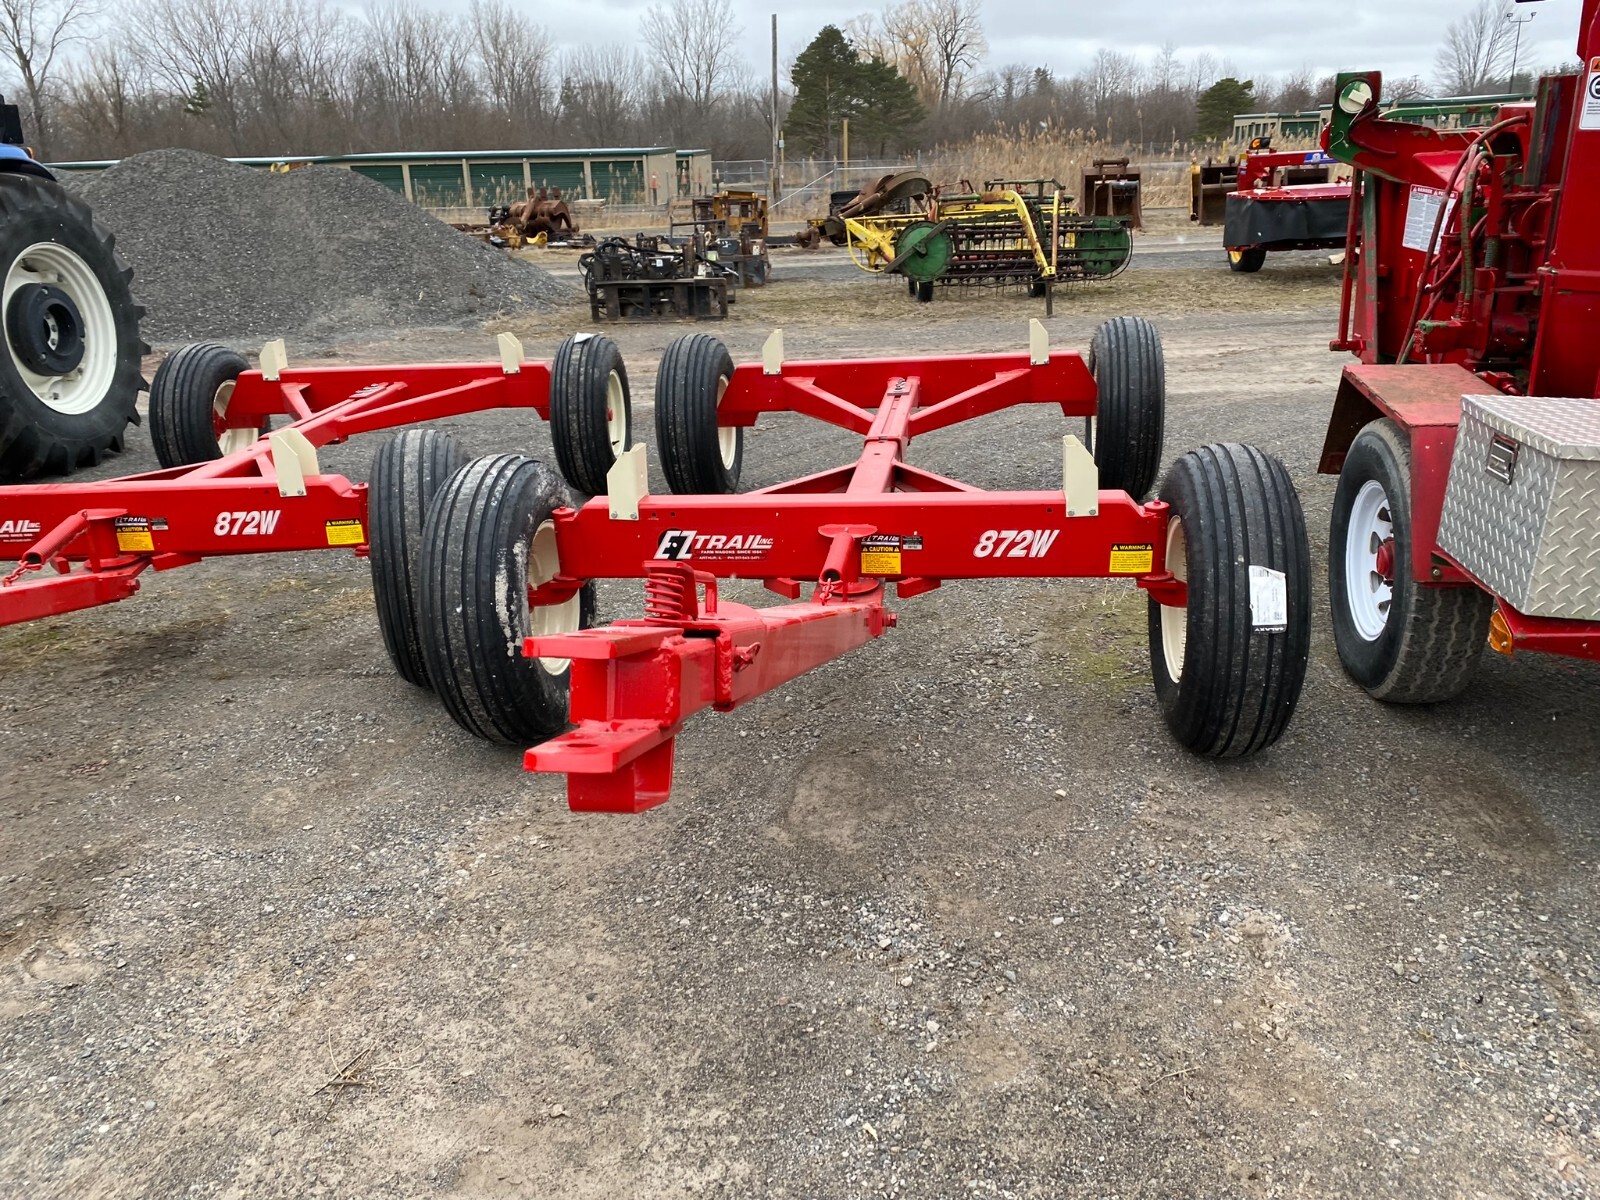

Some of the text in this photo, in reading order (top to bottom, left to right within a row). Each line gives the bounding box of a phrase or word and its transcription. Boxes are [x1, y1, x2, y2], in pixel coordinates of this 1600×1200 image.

[214, 510, 281, 536] 872W
[694, 534, 773, 550] TRAIL
[973, 529, 1060, 558] 872W
